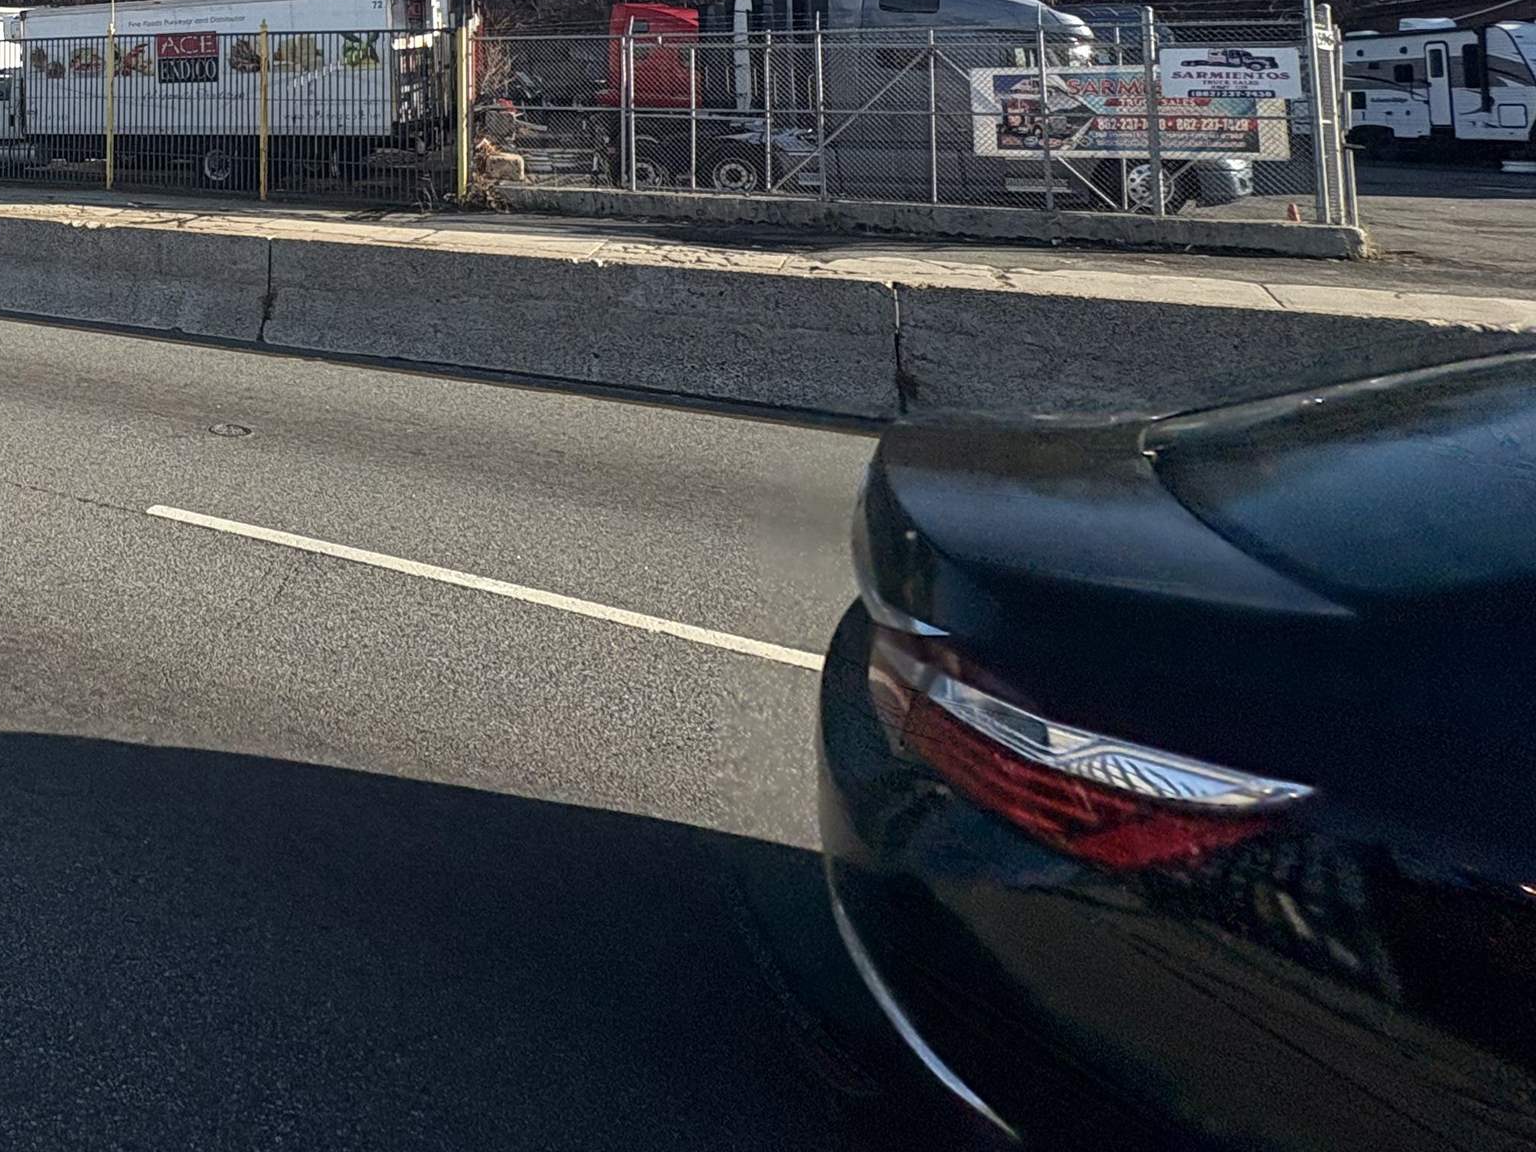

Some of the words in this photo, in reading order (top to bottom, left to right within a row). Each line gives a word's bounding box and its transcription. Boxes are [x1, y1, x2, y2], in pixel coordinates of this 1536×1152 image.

[371, 0, 383, 9] 72
[161, 35, 216, 55] ACE
[160, 57, 217, 81] ENDICO
[1170, 71, 1291, 80] SARMIENTOS
